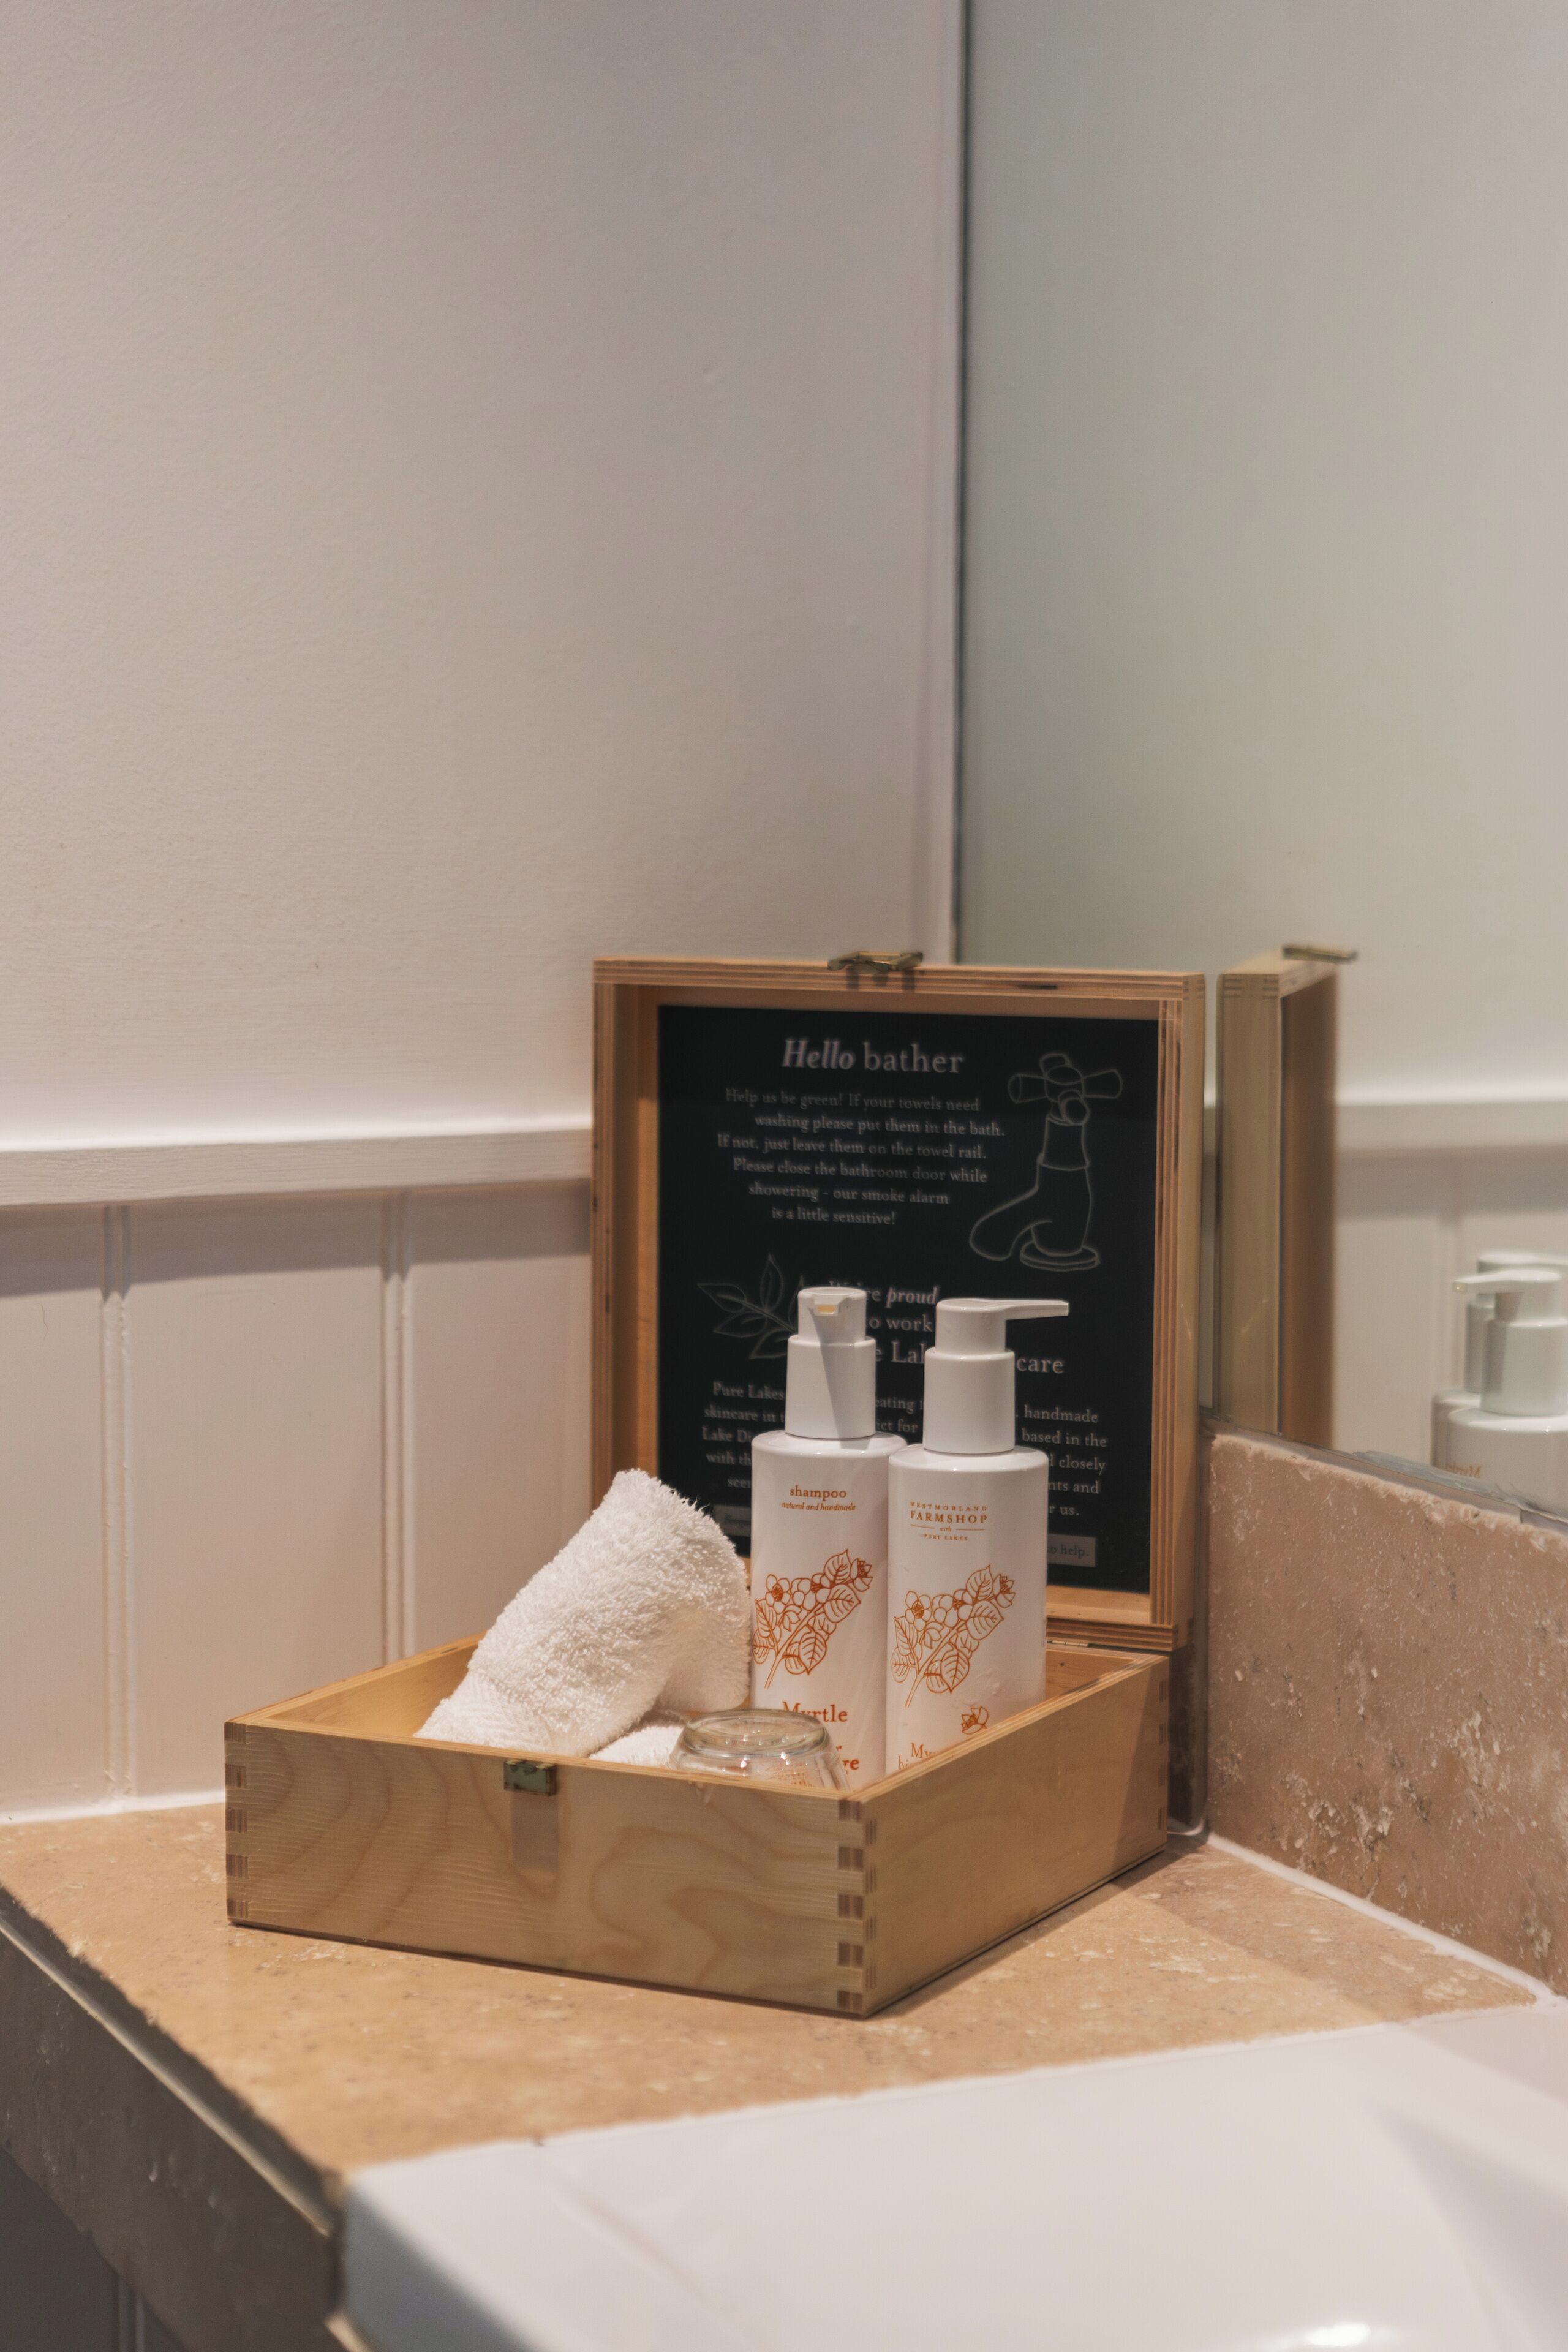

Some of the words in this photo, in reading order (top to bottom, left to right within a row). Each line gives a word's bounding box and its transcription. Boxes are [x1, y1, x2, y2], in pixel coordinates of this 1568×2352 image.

[782, 1038, 856, 1069] Hello
[862, 1040, 963, 1073] bather
[725, 1088, 758, 1107] Help
[762, 1093, 777, 1104] us
[780, 1090, 796, 1104] be
[800, 1093, 843, 1110] green!
[848, 1093, 861, 1107] If
[862, 1098, 894, 1112] your
[899, 1095, 941, 1110] towels
[946, 1097, 980, 1112] need
[755, 1113, 809, 1133] washing
[812, 1115, 853, 1133] please
[858, 1118, 880, 1135] put
[885, 1117, 920, 1133] them
[924, 1120, 940, 1133] in
[943, 1120, 965, 1134] the
[970, 1120, 1005, 1136] bath.
[717, 1133, 731, 1147] If
[762, 1138, 788, 1154] just
[792, 1137, 825, 1151] leave
[829, 1139, 864, 1153] them
[869, 1144, 886, 1155] on
[891, 1141, 912, 1155] the
[917, 1142, 954, 1158] towel
[958, 1143, 986, 1159] rail.
[733, 1156, 774, 1172] Please
[777, 1159, 811, 1174] close
[815, 1161, 836, 1175] the
[840, 1162, 908, 1178] bathroom
[912, 1166, 946, 1180] door
[950, 1167, 988, 1182] while
[748, 1180, 819, 1203] showering
[833, 1189, 858, 1200] our
[862, 1188, 905, 1202] smoke
[909, 1189, 951, 1205] alarm
[772, 1206, 784, 1219] is
[786, 1210, 794, 1219] a
[797, 1206, 829, 1221] little
[832, 1210, 895, 1225] sensitive!
[886, 1284, 940, 1309] proud
[885, 1313, 932, 1332] work
[713, 1381, 744, 1397] Pure
[748, 1383, 785, 1400] Lakes
[1023, 1404, 1099, 1423] handmade
[704, 1404, 759, 1421] skincare
[763, 1410, 776, 1422] in
[897, 1418, 919, 1433] for
[1022, 1427, 1061, 1444] based
[1066, 1433, 1080, 1445] in
[1085, 1433, 1107, 1447] the
[702, 1425, 733, 1442] Lake
[1058, 1454, 1106, 1476] closely
[706, 1450, 735, 1464] with
[1072, 1480, 1099, 1494] and
[790, 1485, 847, 1502] shampoo
[782, 1501, 805, 1510] natural
[820, 1502, 856, 1512] handmade
[910, 1501, 987, 1512] WESTMORLAND
[910, 1510, 987, 1524] FARMSHOP
[1060, 1505, 1079, 1516] us.
[1061, 1544, 1088, 1559] help.
